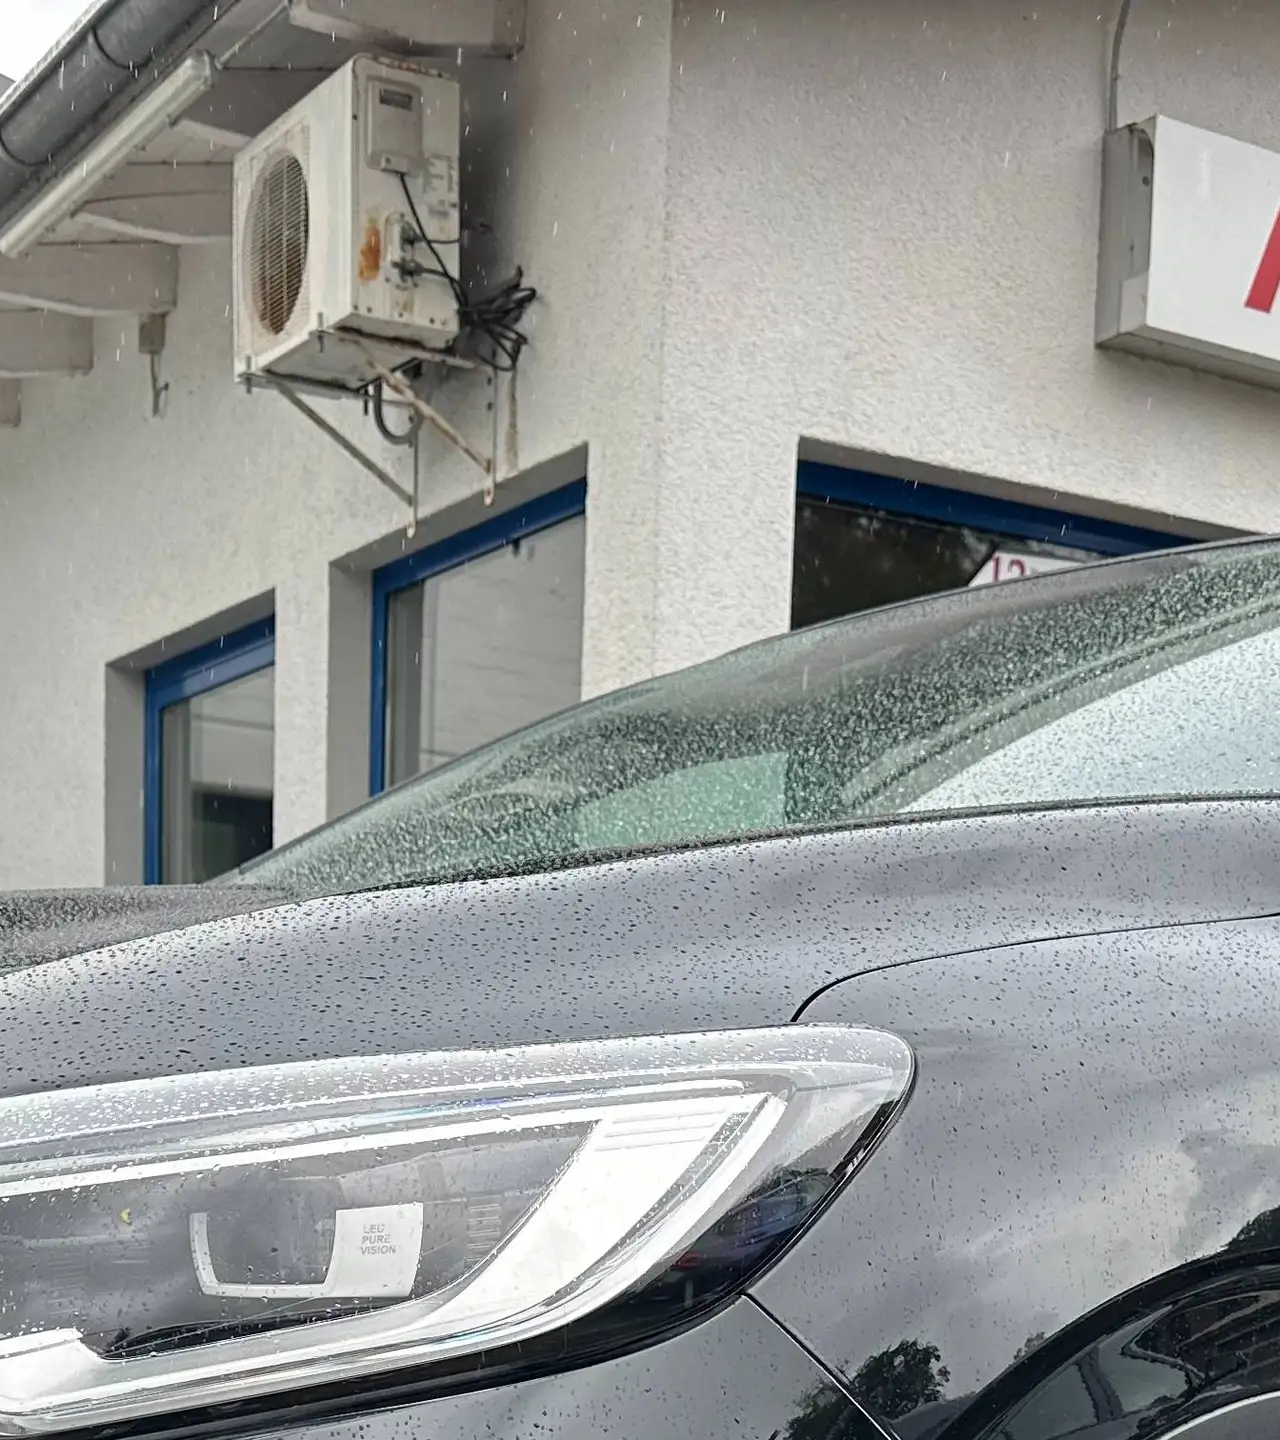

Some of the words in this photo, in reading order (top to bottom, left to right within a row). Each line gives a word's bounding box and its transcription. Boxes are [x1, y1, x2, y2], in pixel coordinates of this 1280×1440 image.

[362, 1223, 386, 1234] LED
[361, 1234, 391, 1244] PURE
[360, 1244, 397, 1255] VISION
